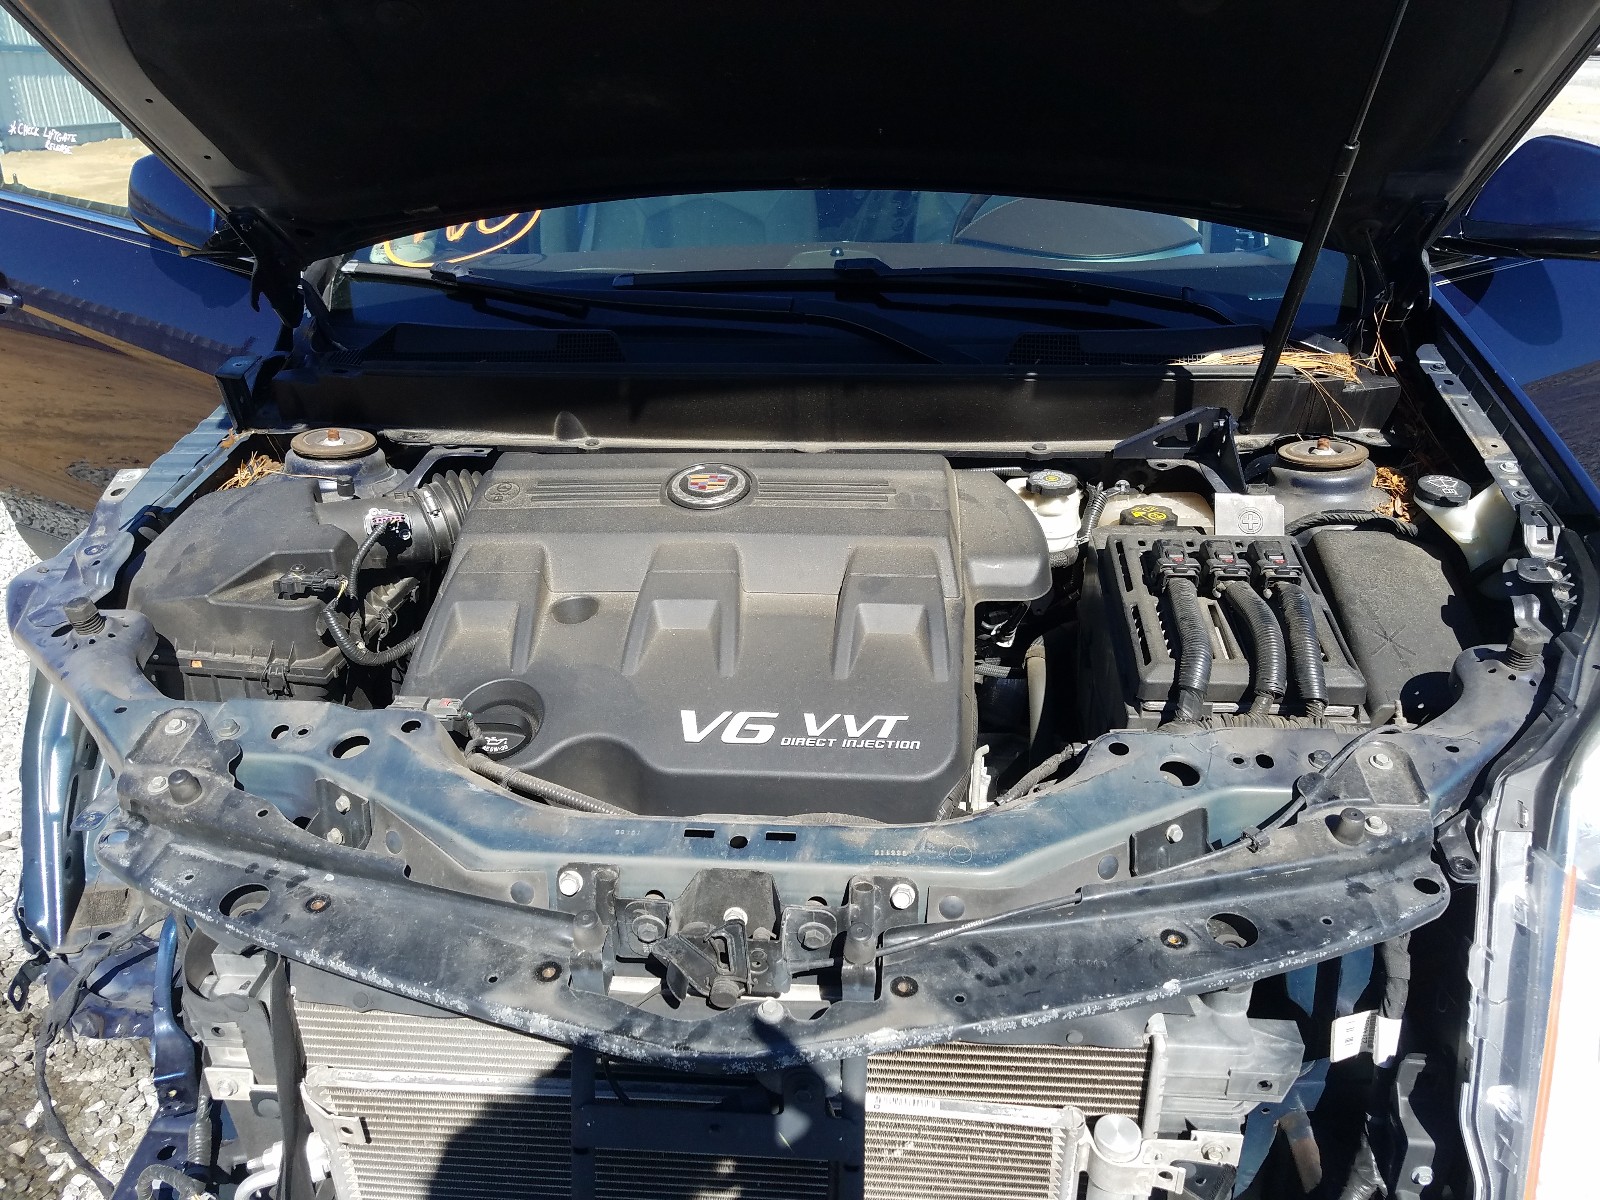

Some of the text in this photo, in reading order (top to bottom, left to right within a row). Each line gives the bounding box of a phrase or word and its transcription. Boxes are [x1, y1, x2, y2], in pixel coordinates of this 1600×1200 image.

[680, 709, 910, 744] V6 VVT
[780, 737, 921, 750] DIRECT INJECTION
